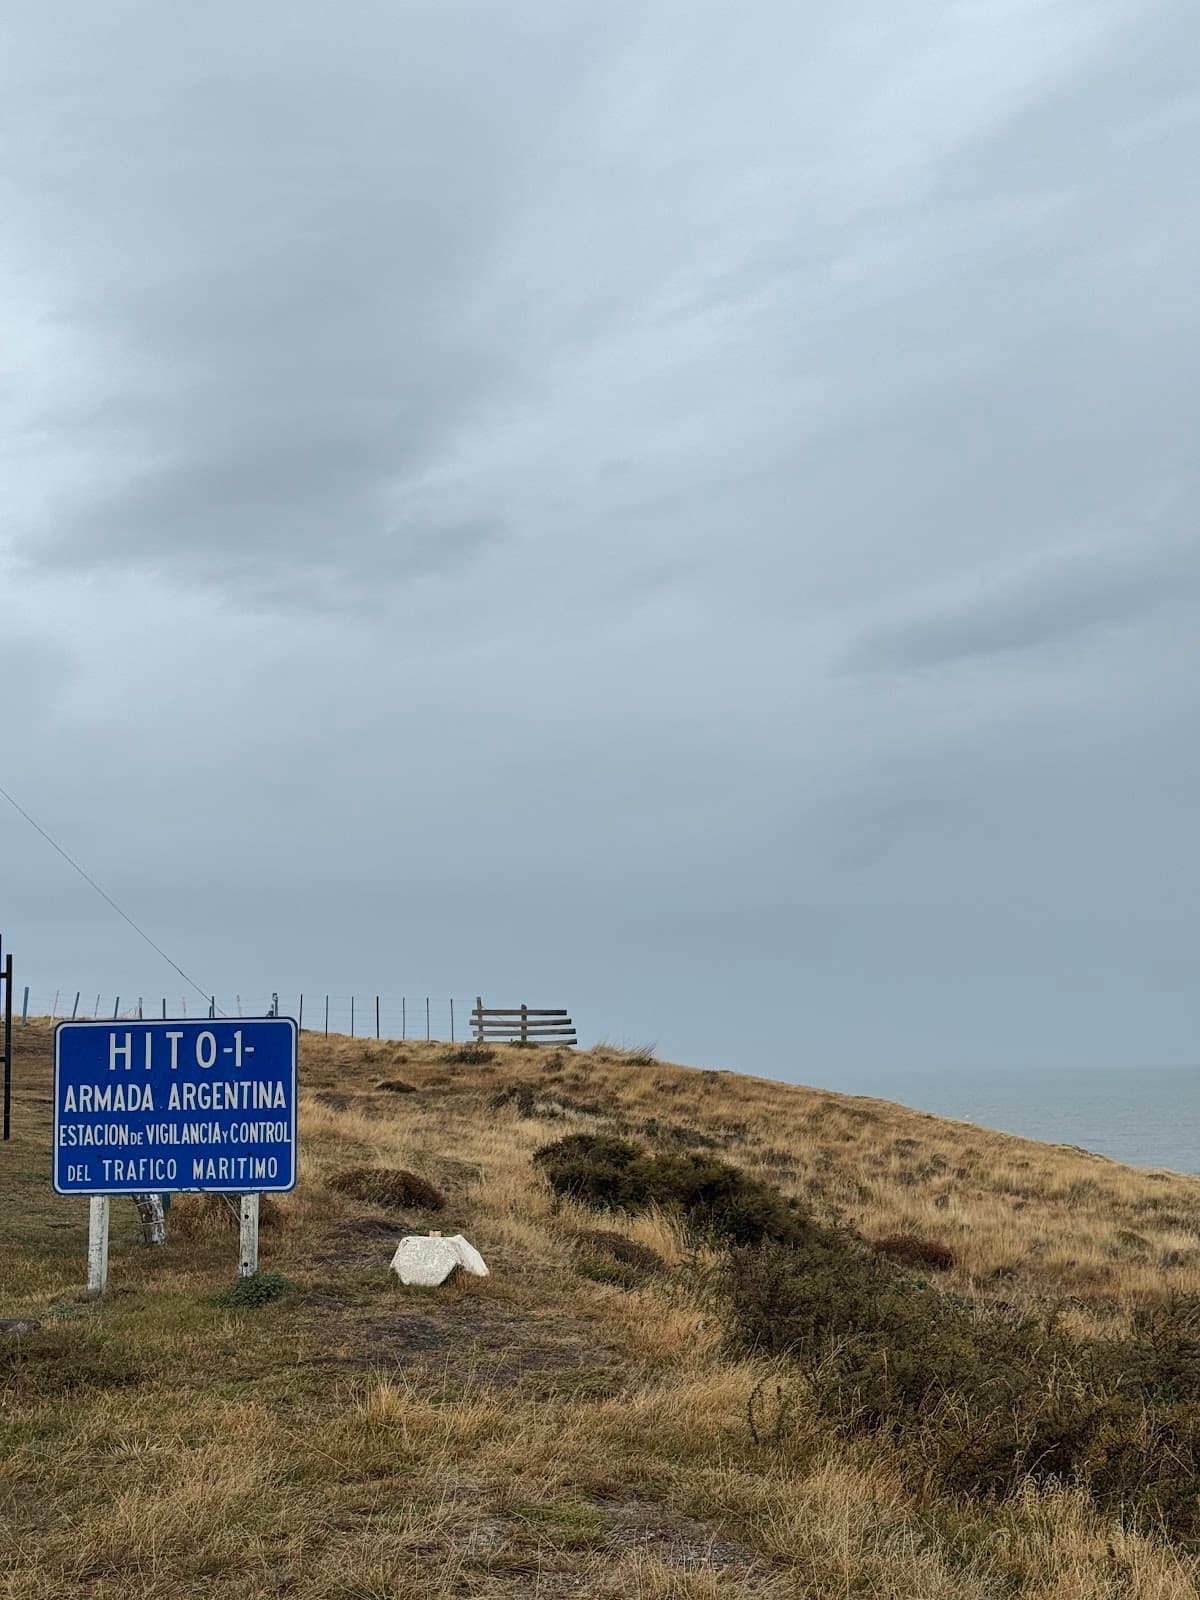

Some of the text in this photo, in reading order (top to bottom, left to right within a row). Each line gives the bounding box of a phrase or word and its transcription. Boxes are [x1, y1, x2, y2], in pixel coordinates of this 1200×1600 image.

[64, 1081, 286, 1113] ARMADA ARGENTINA
[59, 1121, 291, 1146] ESTACION DE VIGILANCIA Y CONTROL
[67, 1156, 278, 1182] DEL TRAFICO MARITIMO
